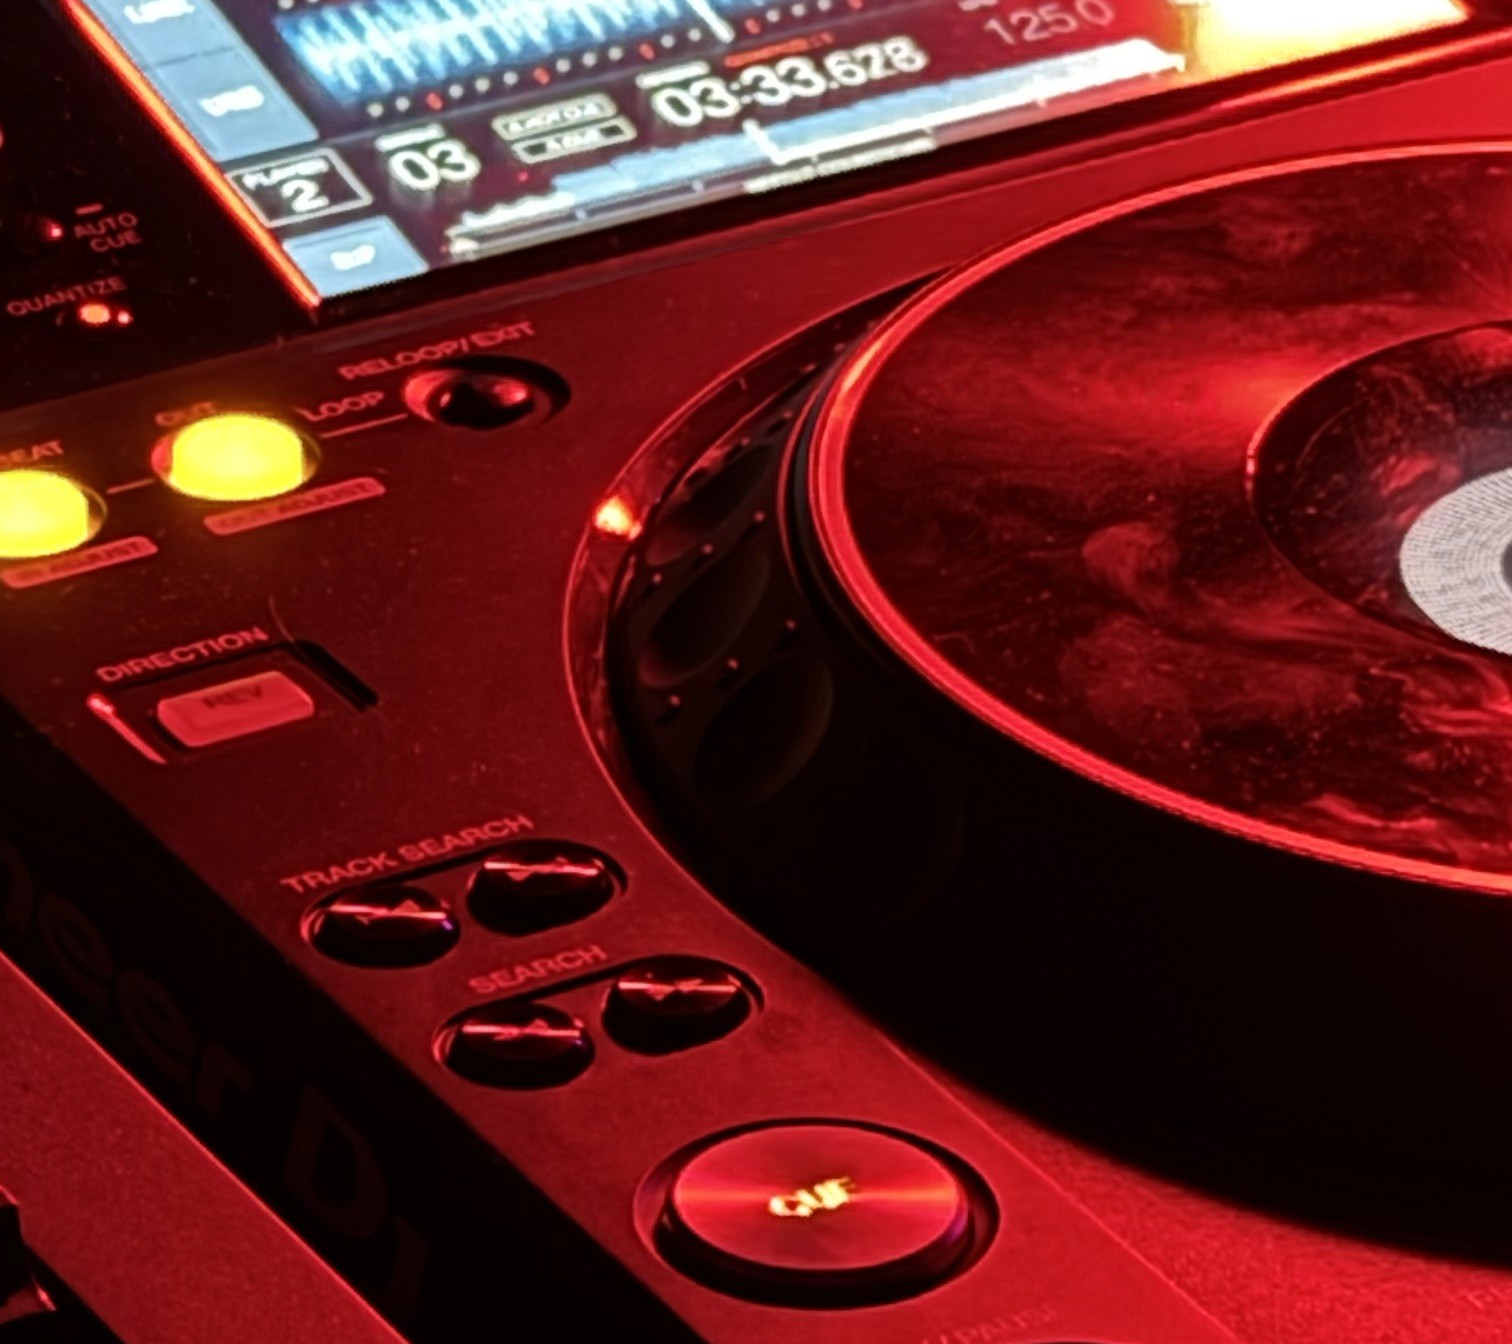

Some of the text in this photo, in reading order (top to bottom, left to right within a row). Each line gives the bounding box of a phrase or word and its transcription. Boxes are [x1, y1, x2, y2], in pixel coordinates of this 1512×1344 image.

[653, 35, 930, 129] 03:33.628
[389, 138, 480, 191] 03
[281, 178, 329, 213] 2
[74, 213, 139, 240] AUTO
[90, 229, 142, 253] CUE
[6, 275, 129, 317] QUANTIZE
[339, 319, 537, 381] RELOOP/EXIT
[95, 628, 269, 682] DIRECTION
[201, 682, 264, 711] REV
[279, 813, 535, 894] TRACK SEARCH
[467, 945, 609, 995] SEARCH
